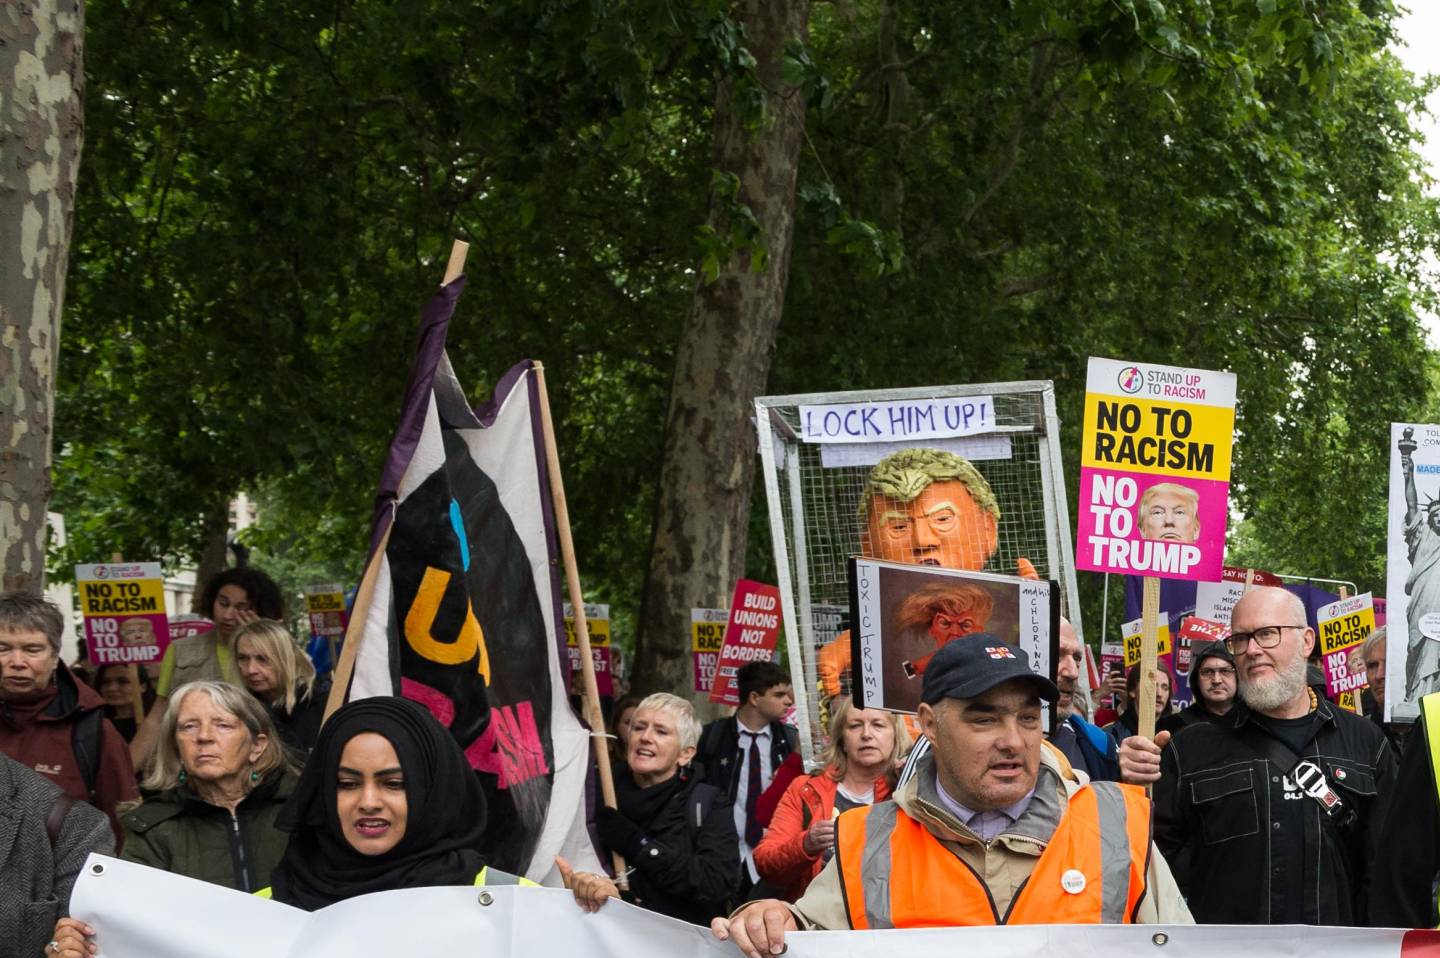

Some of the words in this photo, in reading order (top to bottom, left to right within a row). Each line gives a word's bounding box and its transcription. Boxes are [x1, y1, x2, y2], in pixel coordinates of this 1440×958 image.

[1147, 370, 1182, 385] STAND
[1185, 375, 1201, 387] UP
[1146, 383, 1161, 395] TO
[1164, 385, 1206, 400] RACISM
[807, 407, 882, 437] LOCK
[887, 404, 936, 436] HIM
[944, 403, 987, 430] UP!
[1096, 400, 1141, 434] NO
[1151, 406, 1193, 439] TO
[1094, 432, 1215, 473] RACISM
[1091, 474, 1138, 508] NO
[1090, 504, 1133, 538] TO
[1088, 535, 1201, 575] TRUMP
[1223, 569, 1236, 578] SAY
[85, 583, 112, 598] NO
[116, 583, 140, 597] TO
[858, 565, 872, 628] TOXIC
[88, 597, 157, 612] RACISM
[744, 593, 776, 611] BUILD
[90, 618, 118, 633] NO
[733, 609, 779, 629] UNIONS
[1324, 621, 1342, 637] NO
[1344, 615, 1360, 630] TO
[697, 625, 715, 636] NO
[740, 628, 766, 645] NOT
[1030, 599, 1041, 674] CHLORINA
[1326, 624, 1371, 650] RACISM
[93, 633, 118, 647] TO
[698, 637, 721, 649] RAC
[1127, 637, 1141, 650] NO
[95, 645, 160, 662] TRUMP
[698, 654, 716, 666] NO
[722, 644, 772, 662] BORDERS
[1327, 651, 1347, 668] NO
[861, 634, 876, 702] TRUMP
[1329, 665, 1347, 679] TO
[1331, 671, 1368, 694] TRUM
